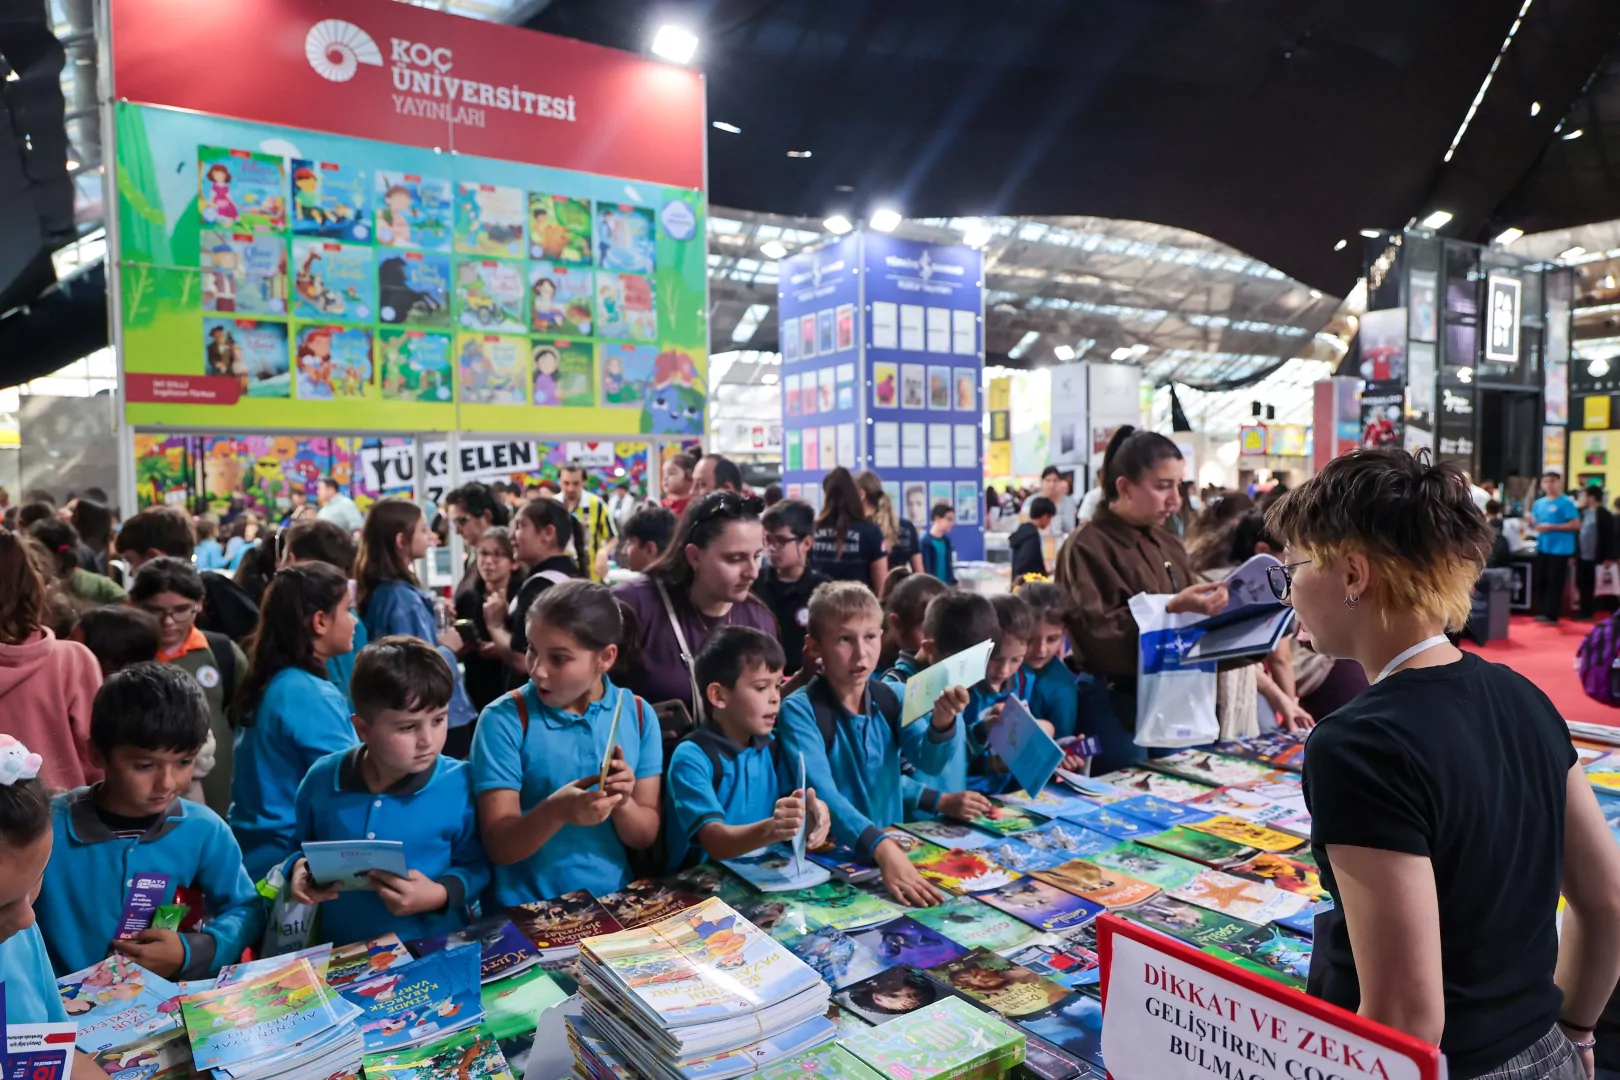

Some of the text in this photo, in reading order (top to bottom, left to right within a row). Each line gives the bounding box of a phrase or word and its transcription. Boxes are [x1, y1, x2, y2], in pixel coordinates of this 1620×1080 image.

[390, 37, 453, 73] KOÇ
[391, 63, 577, 122] ÜNİVERSİTESİ
[392, 94, 486, 128] YAYINLARI
[369, 983, 439, 1011] KABARCIK
[397, 980, 430, 996] VAR?
[111, 1012, 150, 1031] UZUN
[1144, 962, 1391, 1080] DİKKAT VE ZEKA
[1145, 997, 1277, 1071] GELİŞTİREN
[211, 1036, 251, 1051] AYAK
